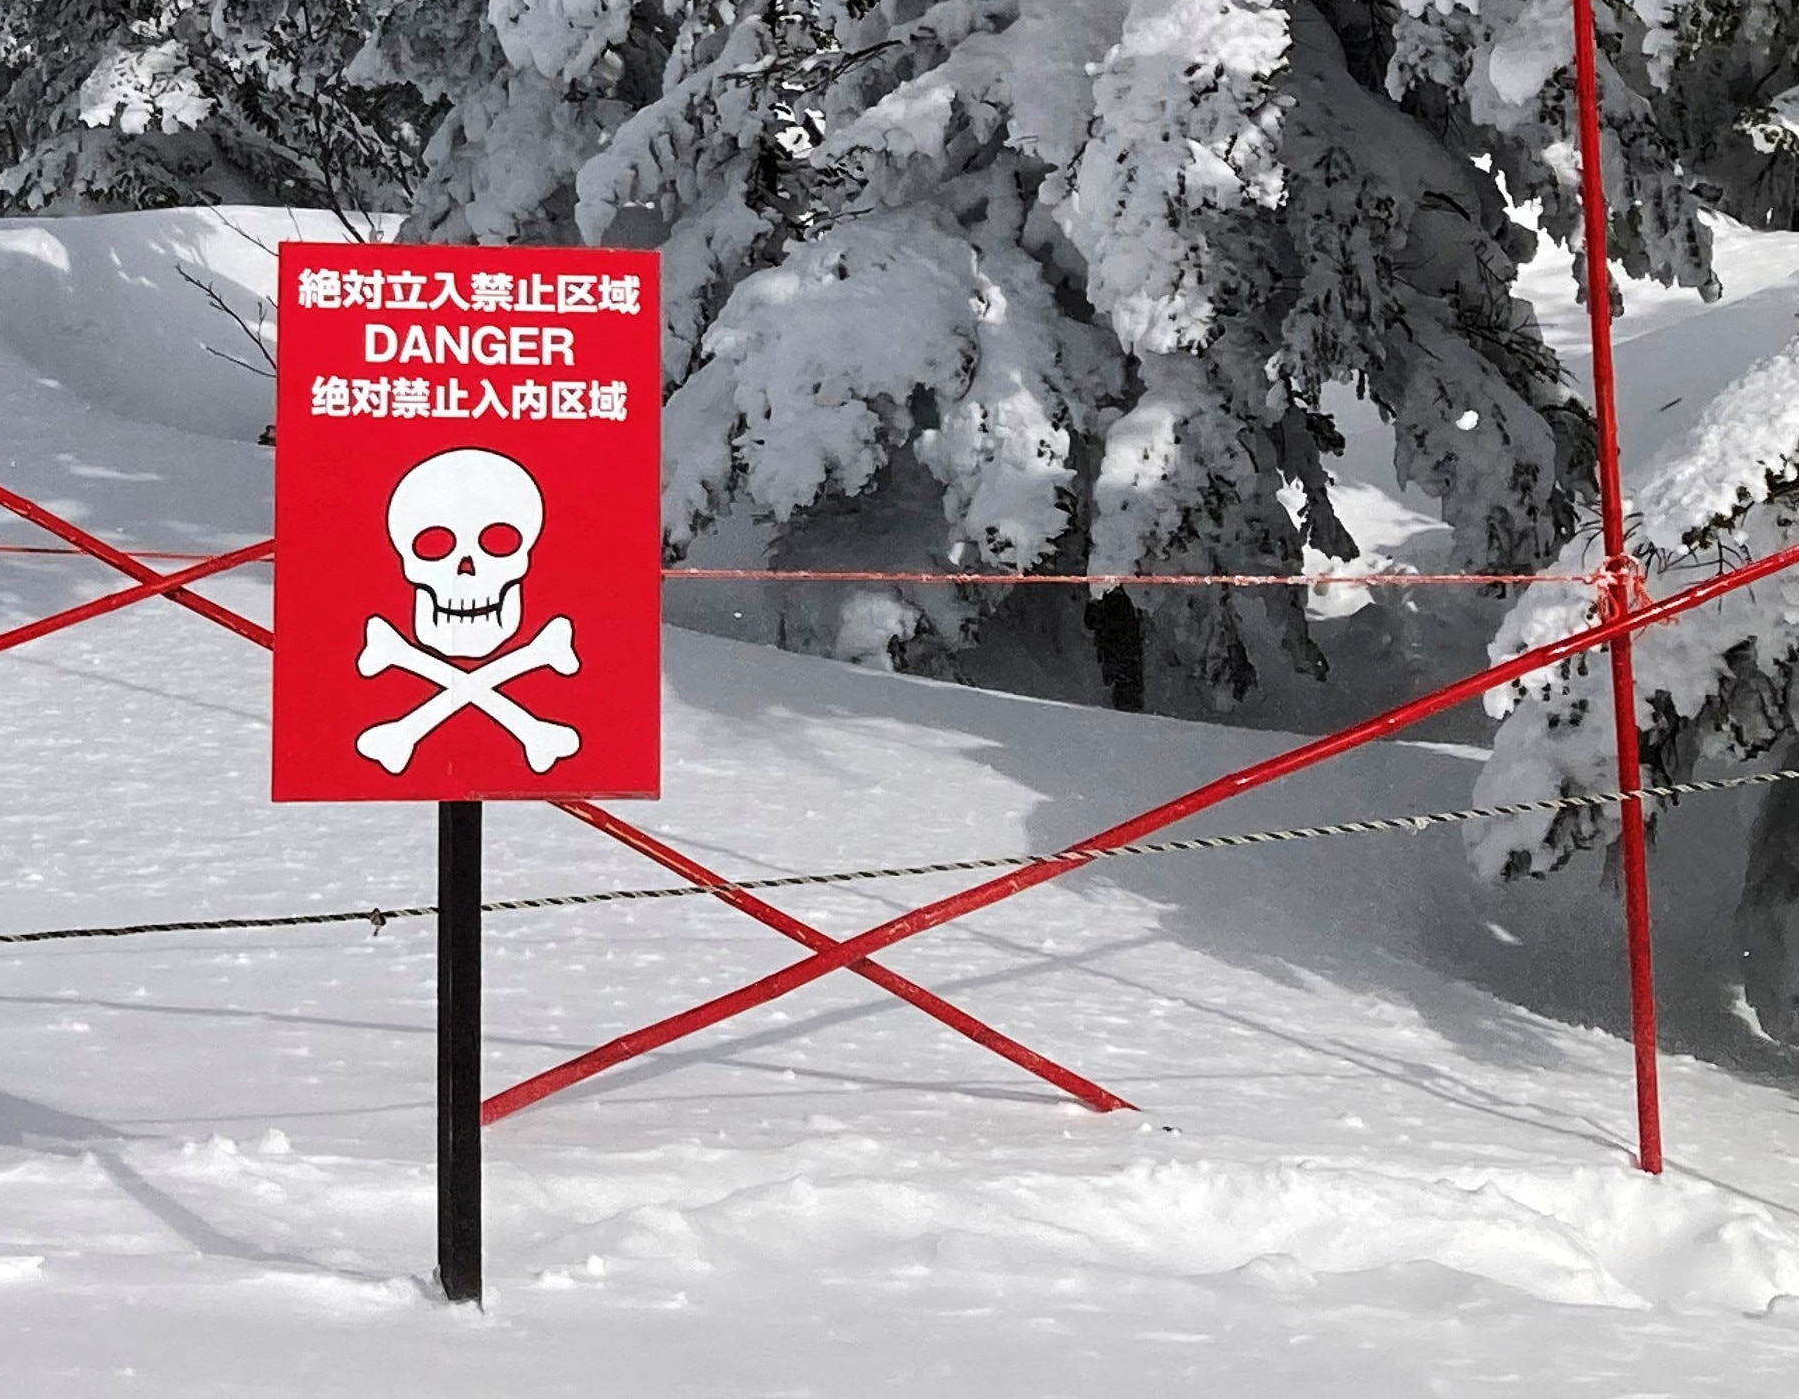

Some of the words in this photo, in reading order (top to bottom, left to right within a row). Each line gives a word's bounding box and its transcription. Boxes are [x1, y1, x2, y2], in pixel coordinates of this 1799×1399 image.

[298, 268, 641, 315] 絶対立入禁止区域
[364, 324, 575, 366] DANGER
[311, 376, 628, 421] 绝对禁止入内区域
